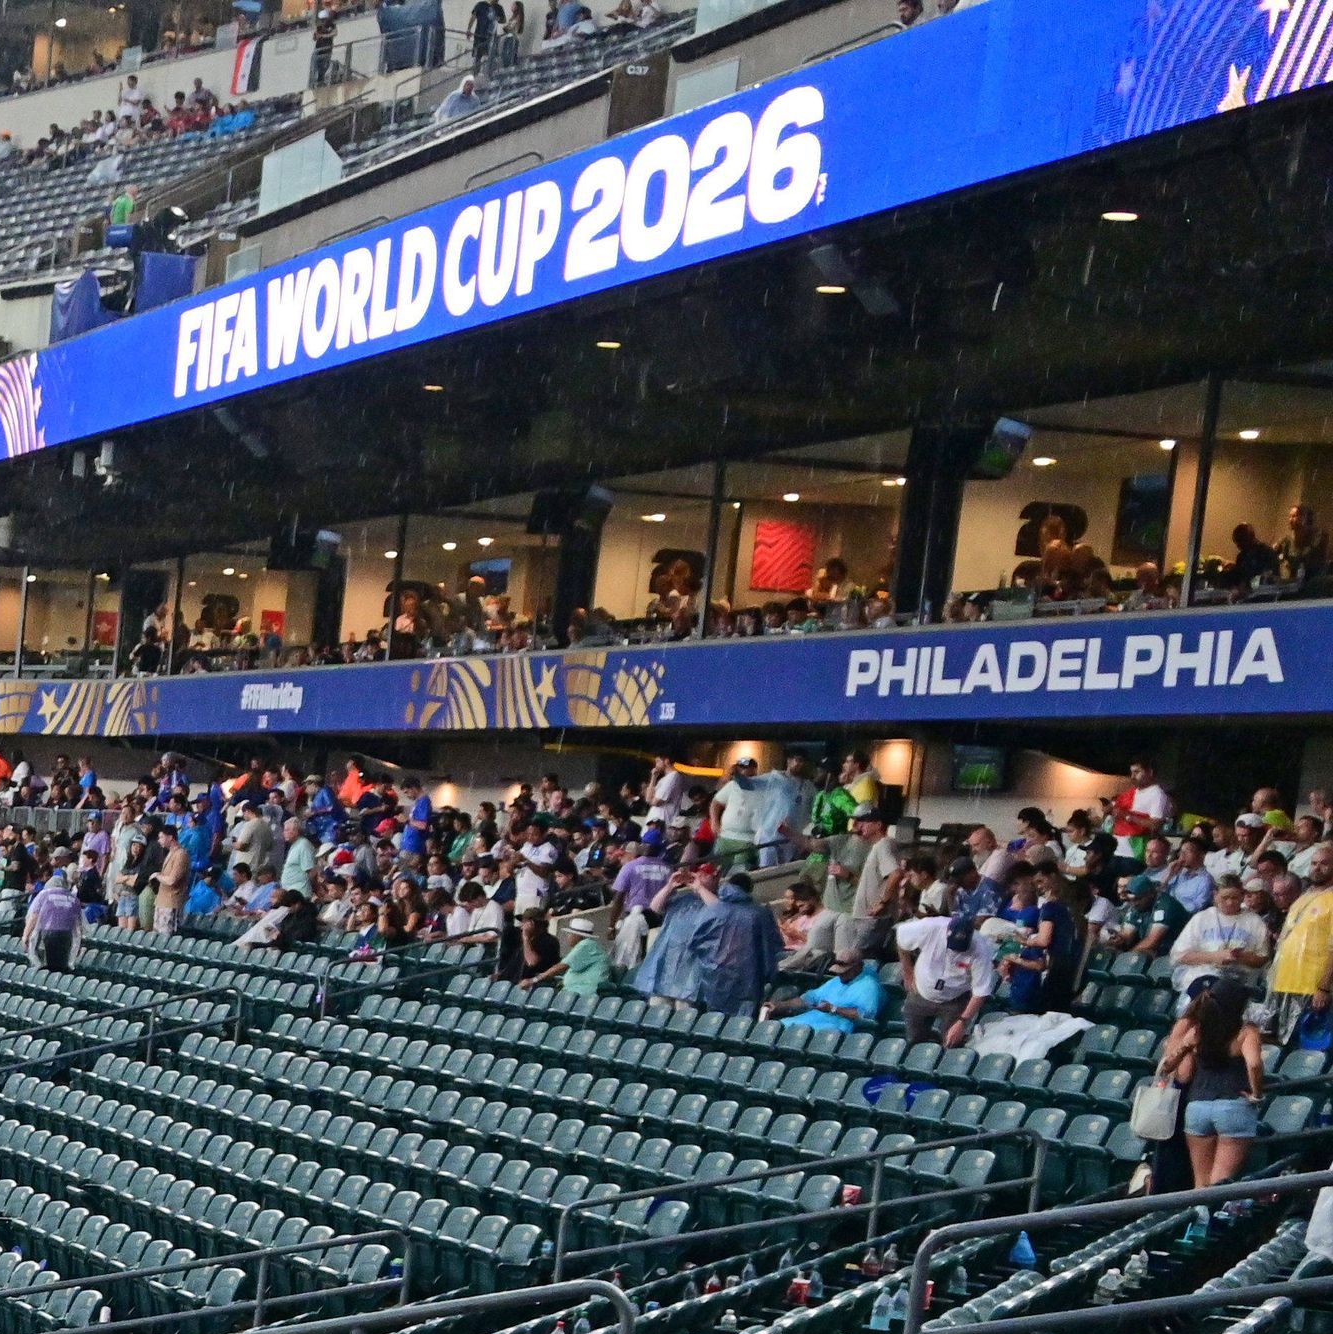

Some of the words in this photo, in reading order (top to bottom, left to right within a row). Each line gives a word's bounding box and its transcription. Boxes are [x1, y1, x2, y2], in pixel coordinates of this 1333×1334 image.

[173, 294, 260, 401] FIFA
[266, 224, 437, 372] WORLD
[442, 179, 563, 319] CUP
[562, 84, 827, 283] 2026
[845, 627, 1284, 697] PHILADELPHIA
